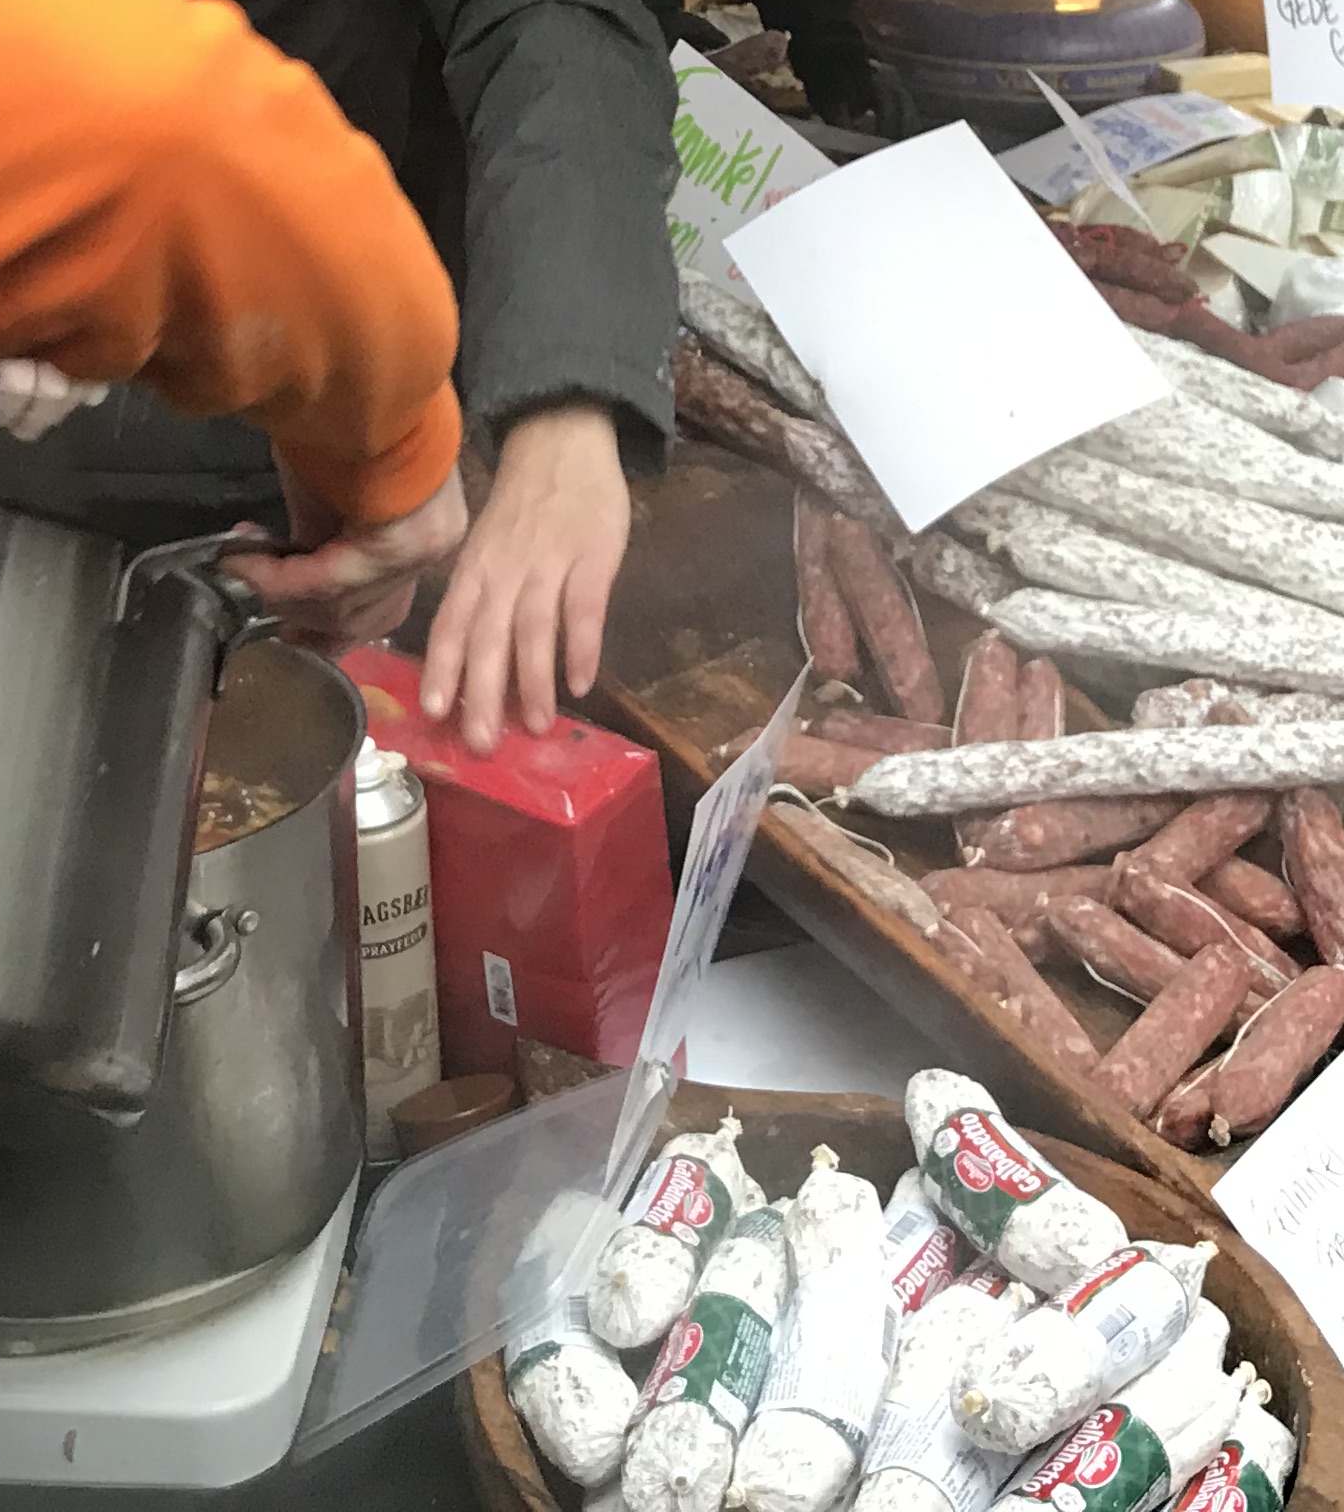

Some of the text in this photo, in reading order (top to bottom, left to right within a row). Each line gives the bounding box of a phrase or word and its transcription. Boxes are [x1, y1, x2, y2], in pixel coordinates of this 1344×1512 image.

[642, 1158, 697, 1226] Galbanetto
[959, 1112, 1042, 1193] Galbanetto
[1022, 1408, 1114, 1493] Galbanetto
